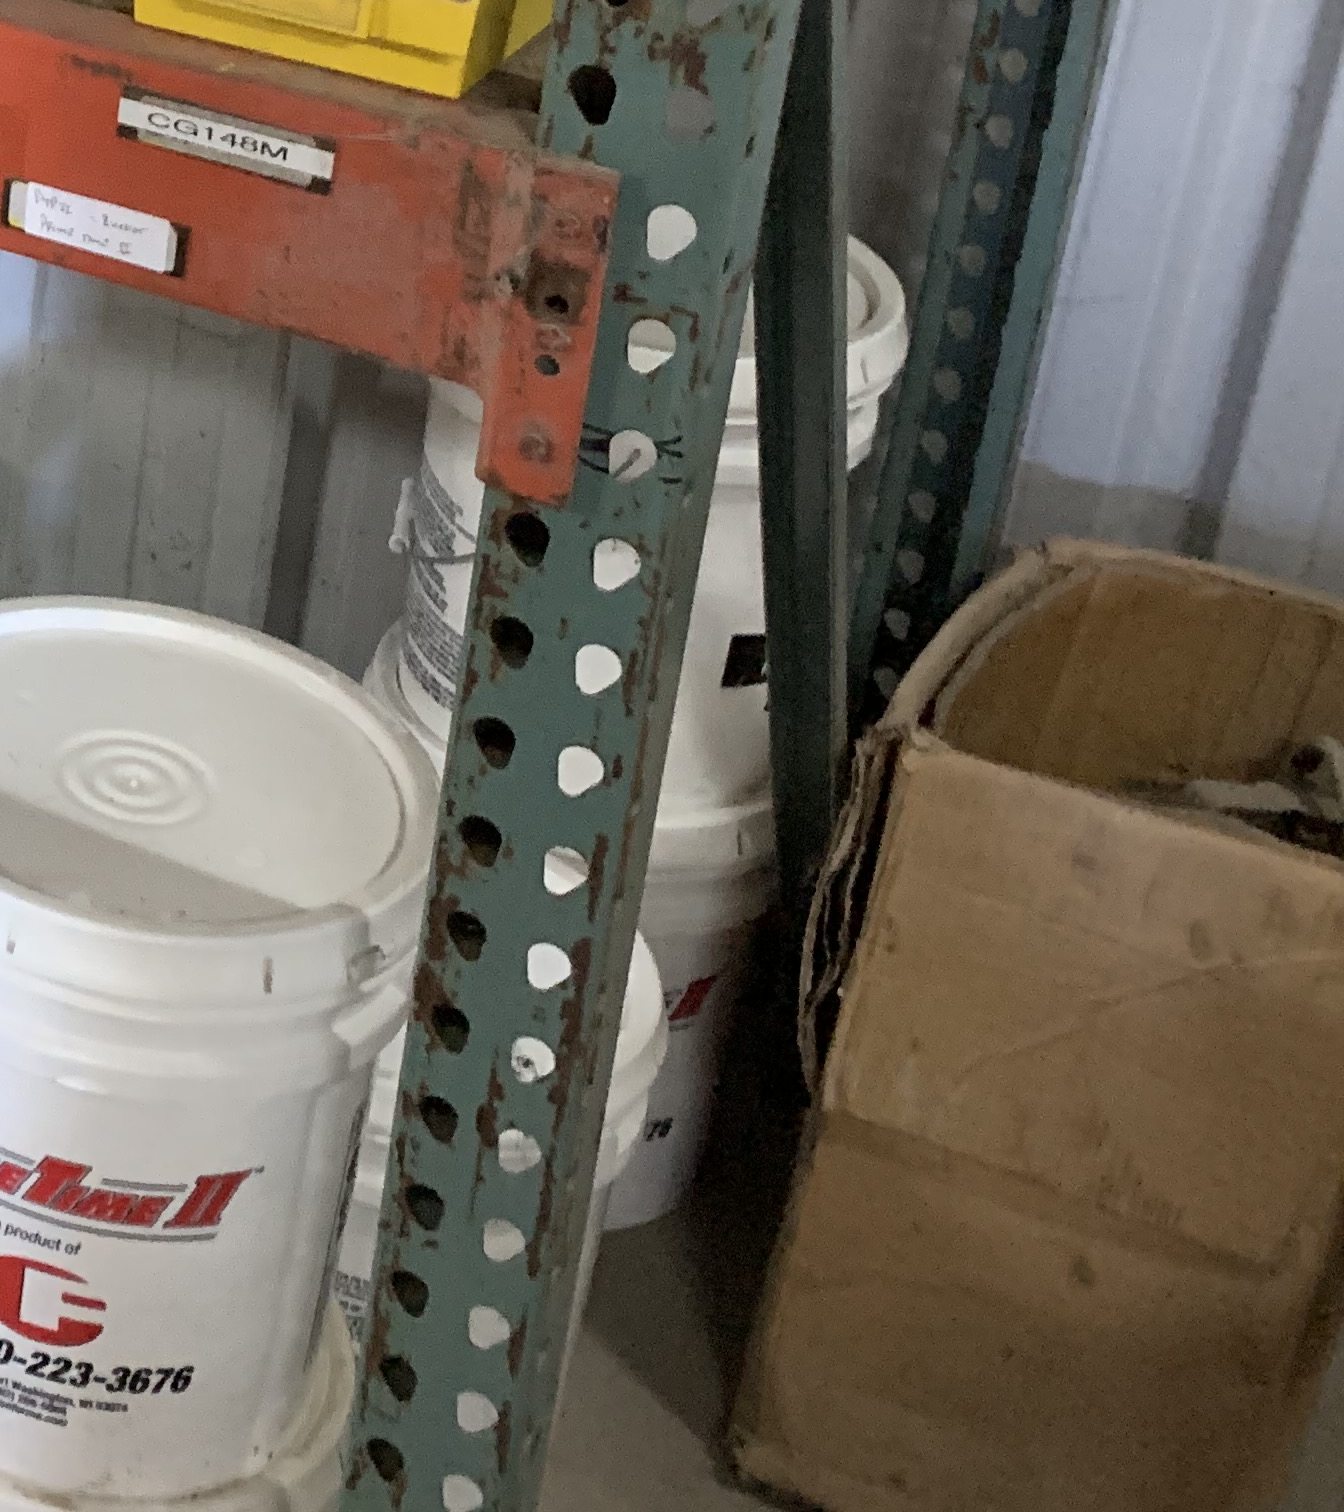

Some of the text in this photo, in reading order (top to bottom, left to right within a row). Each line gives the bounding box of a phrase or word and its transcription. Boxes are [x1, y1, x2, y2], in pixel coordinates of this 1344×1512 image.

[146, 111, 290, 162] CG148M
[3, 1219, 64, 1255] product
[64, 1240, 83, 1255] of
